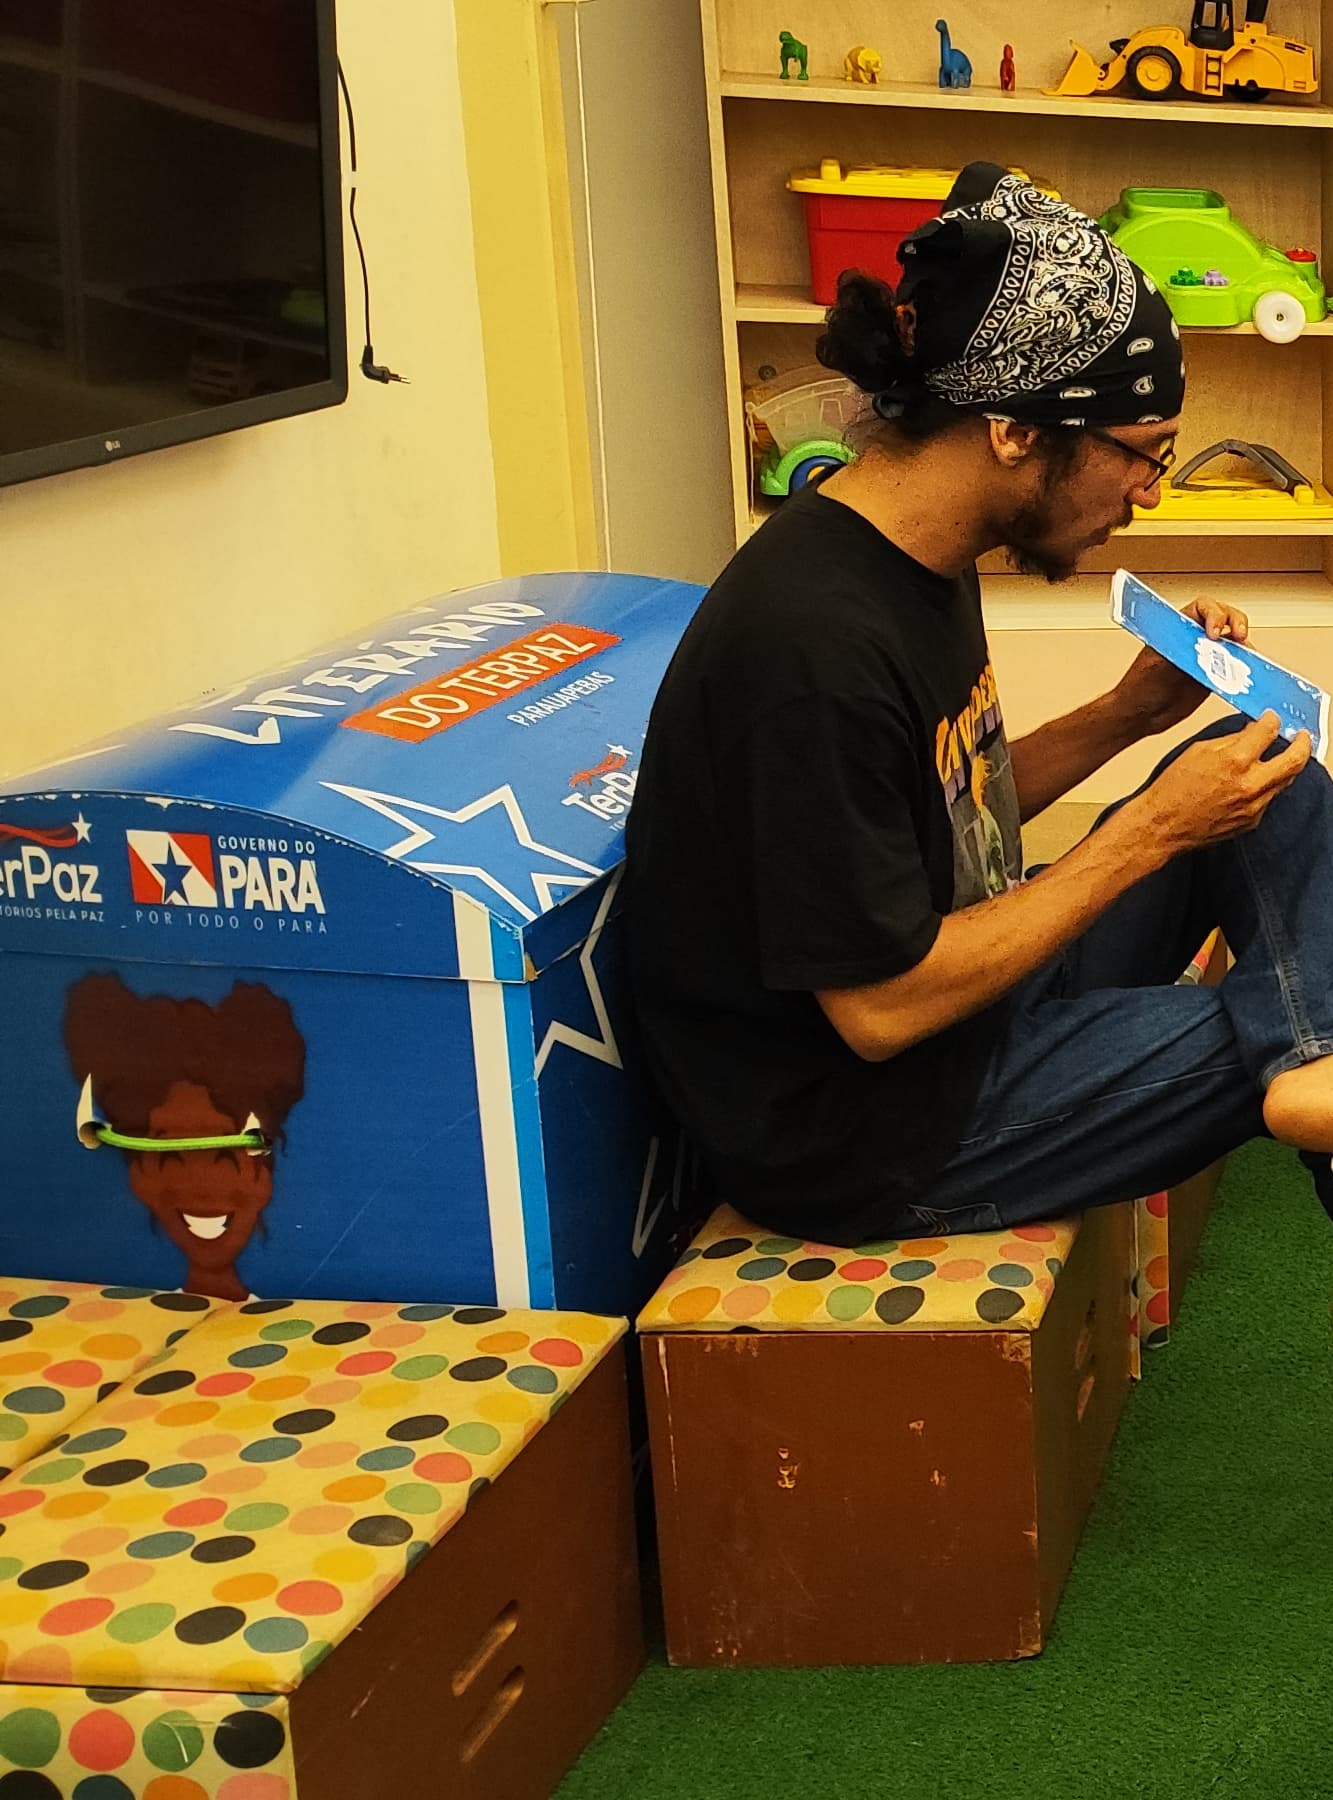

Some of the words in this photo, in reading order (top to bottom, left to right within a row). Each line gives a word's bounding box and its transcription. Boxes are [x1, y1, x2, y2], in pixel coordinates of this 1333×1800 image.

[168, 600, 546, 745] LITERÁRIO
[376, 693, 469, 729] DO
[451, 631, 598, 699] TERPAZ
[507, 671, 616, 728] PARAUAPEBAS
[561, 769, 639, 821] TerP
[217, 835, 289, 853] GOVERNO
[295, 840, 316, 855] DO
[46, 908, 77, 920] PELA
[81, 910, 105, 922] PAZ
[135, 910, 173, 925] POR
[187, 913, 240, 929] TODO
[253, 917, 264, 931] O
